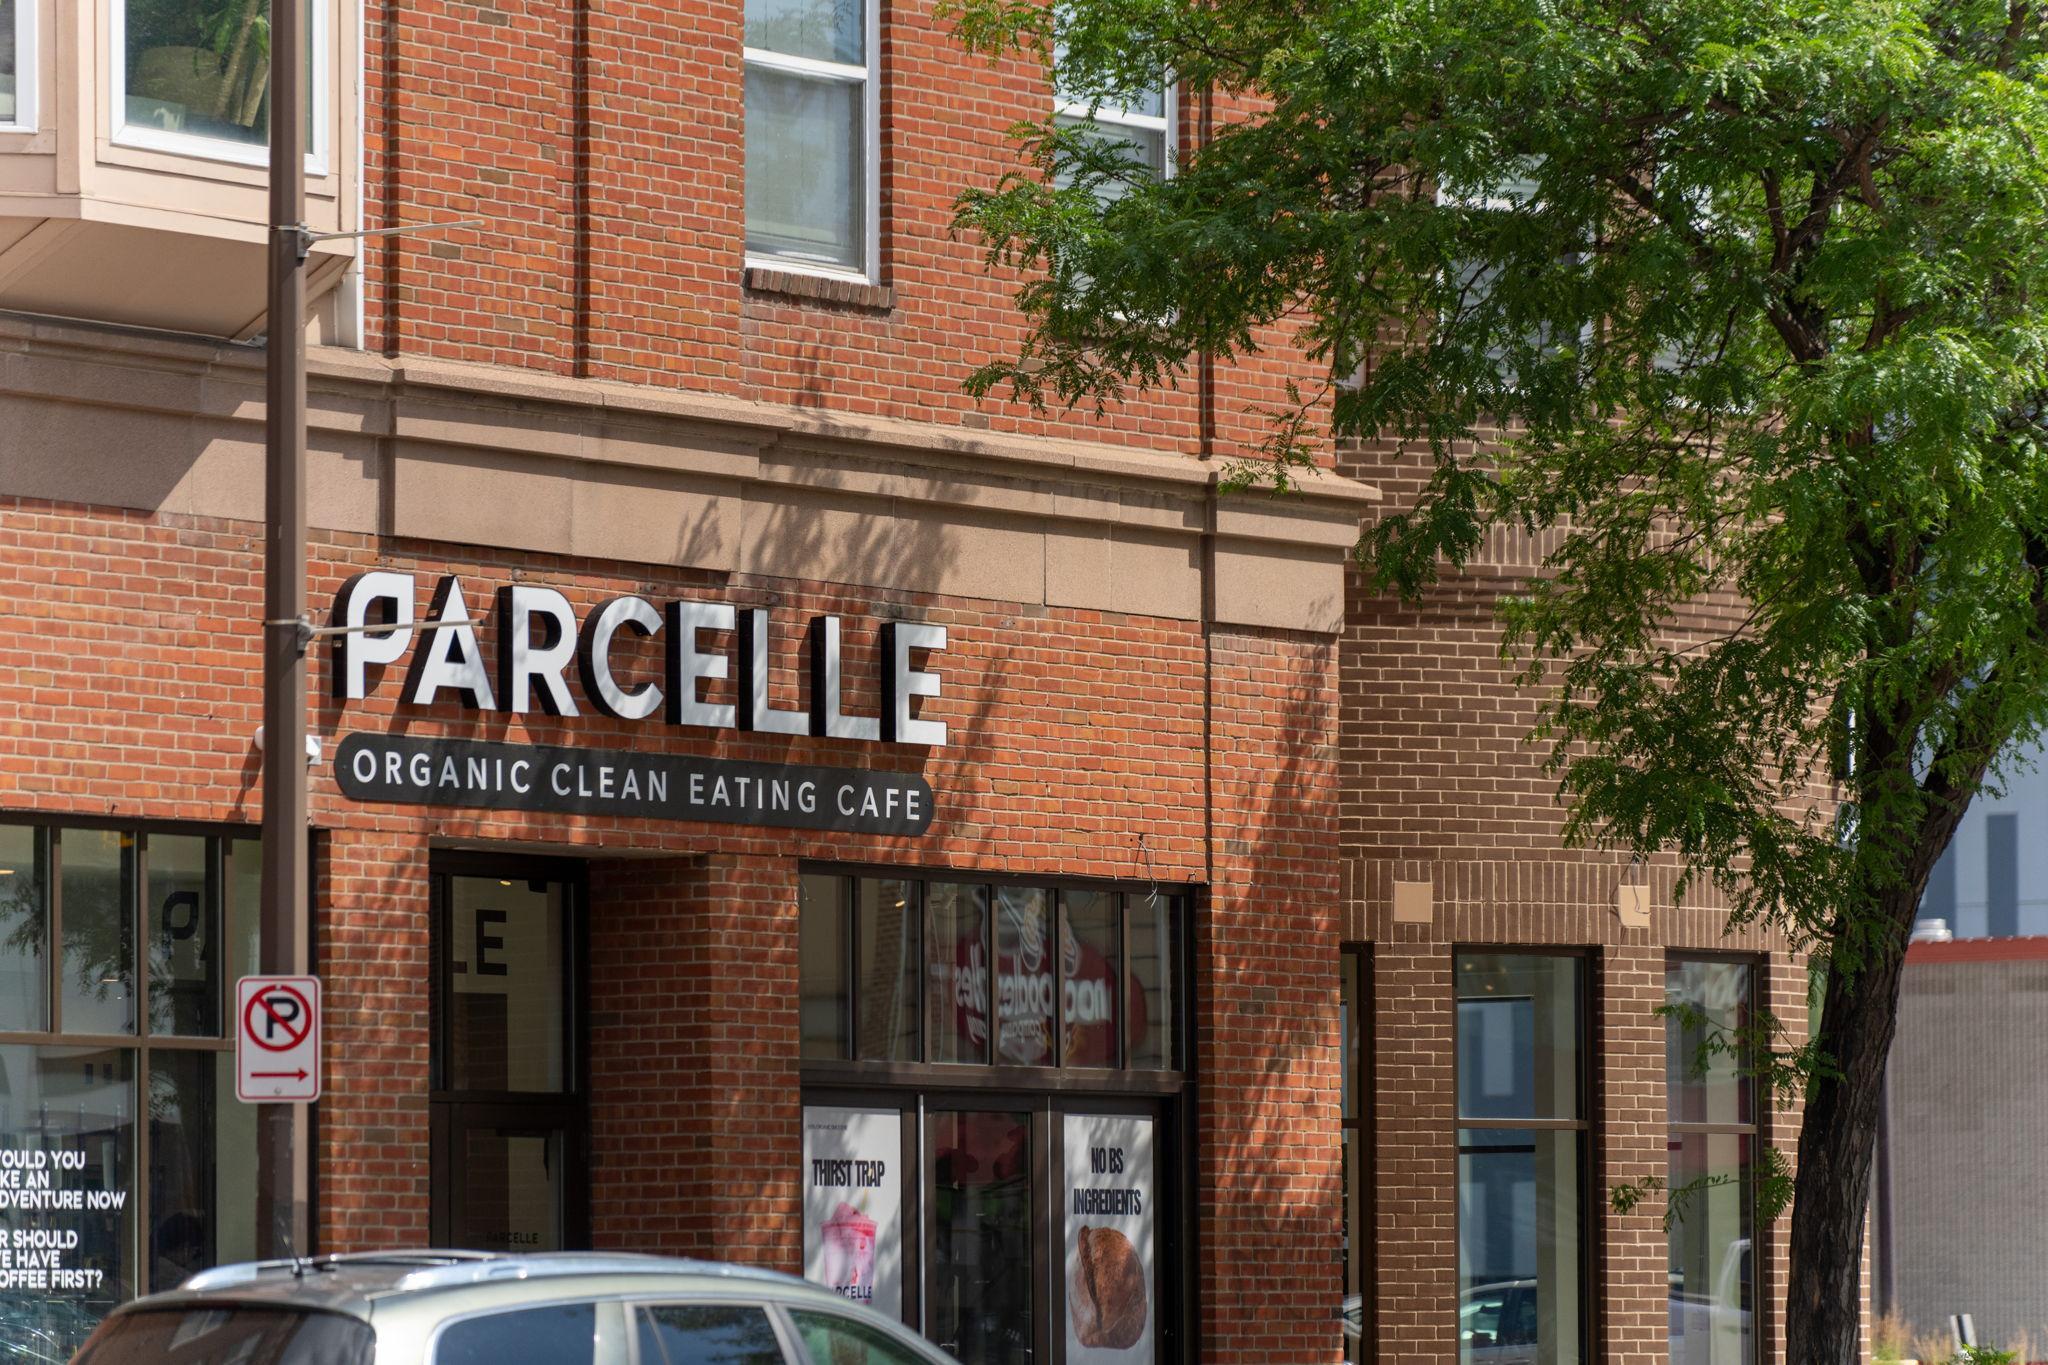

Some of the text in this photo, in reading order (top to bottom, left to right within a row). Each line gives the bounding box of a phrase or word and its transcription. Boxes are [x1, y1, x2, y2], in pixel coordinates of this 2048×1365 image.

[340, 571, 948, 747] PARCELLE
[353, 749, 920, 821] ORGANIC CLEAN EATING CAFE
[0, 1150, 85, 1170] OULD YOU
[1091, 1147, 1123, 1174] NO BS
[26, 1170, 49, 1189] AN
[813, 1159, 885, 1187] THIRST TRAP
[87, 1191, 126, 1210] NOW
[1073, 1188, 1142, 1216] INGREDIENTS
[13, 1230, 78, 1249] SHOULD
[16, 1249, 60, 1269] HAVE
[52, 1269, 103, 1289] FIRST?
